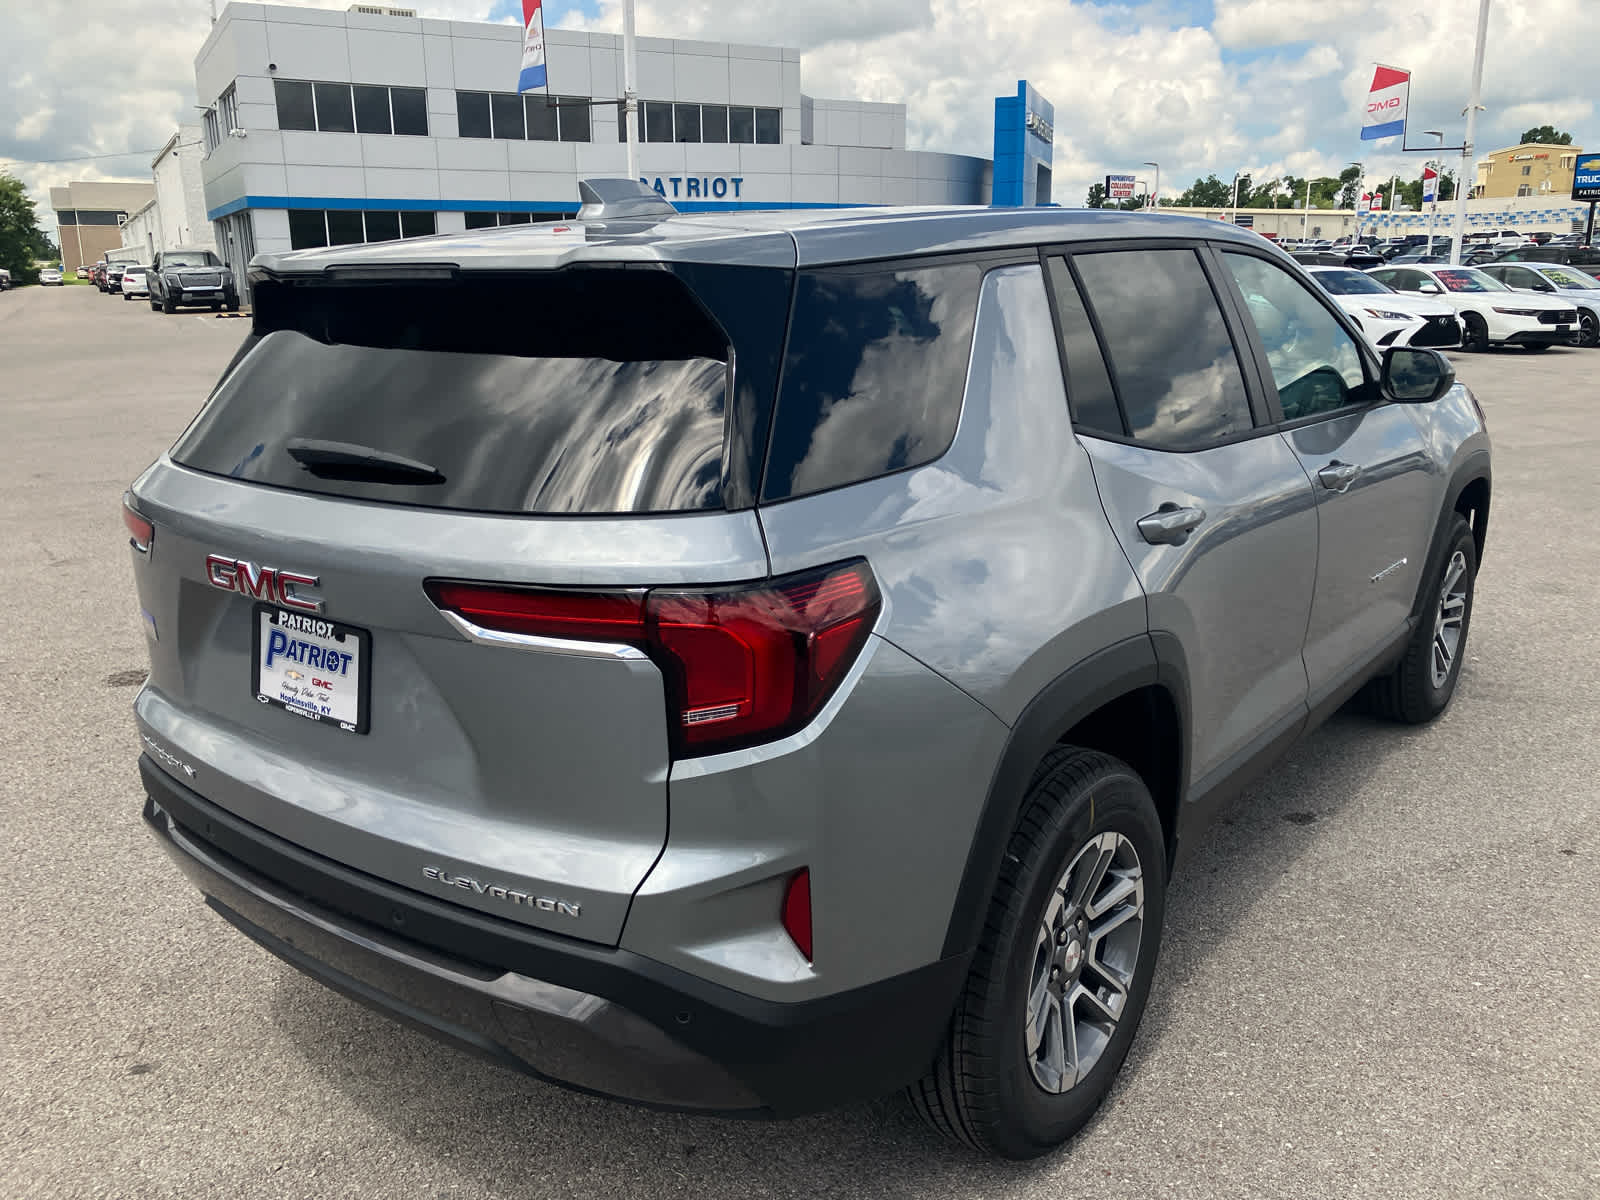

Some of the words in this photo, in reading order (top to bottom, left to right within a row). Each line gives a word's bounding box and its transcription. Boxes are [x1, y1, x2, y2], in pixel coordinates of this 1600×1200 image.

[206, 553, 322, 612] GMC
[278, 611, 335, 638] PATRIOT
[265, 628, 353, 675] PATRIOT
[312, 677, 333, 690] GMC
[280, 692, 319, 712] Hopkinsville,
[320, 704, 332, 716] KY
[340, 721, 356, 732] GMC
[422, 866, 581, 918] ELEVATION
